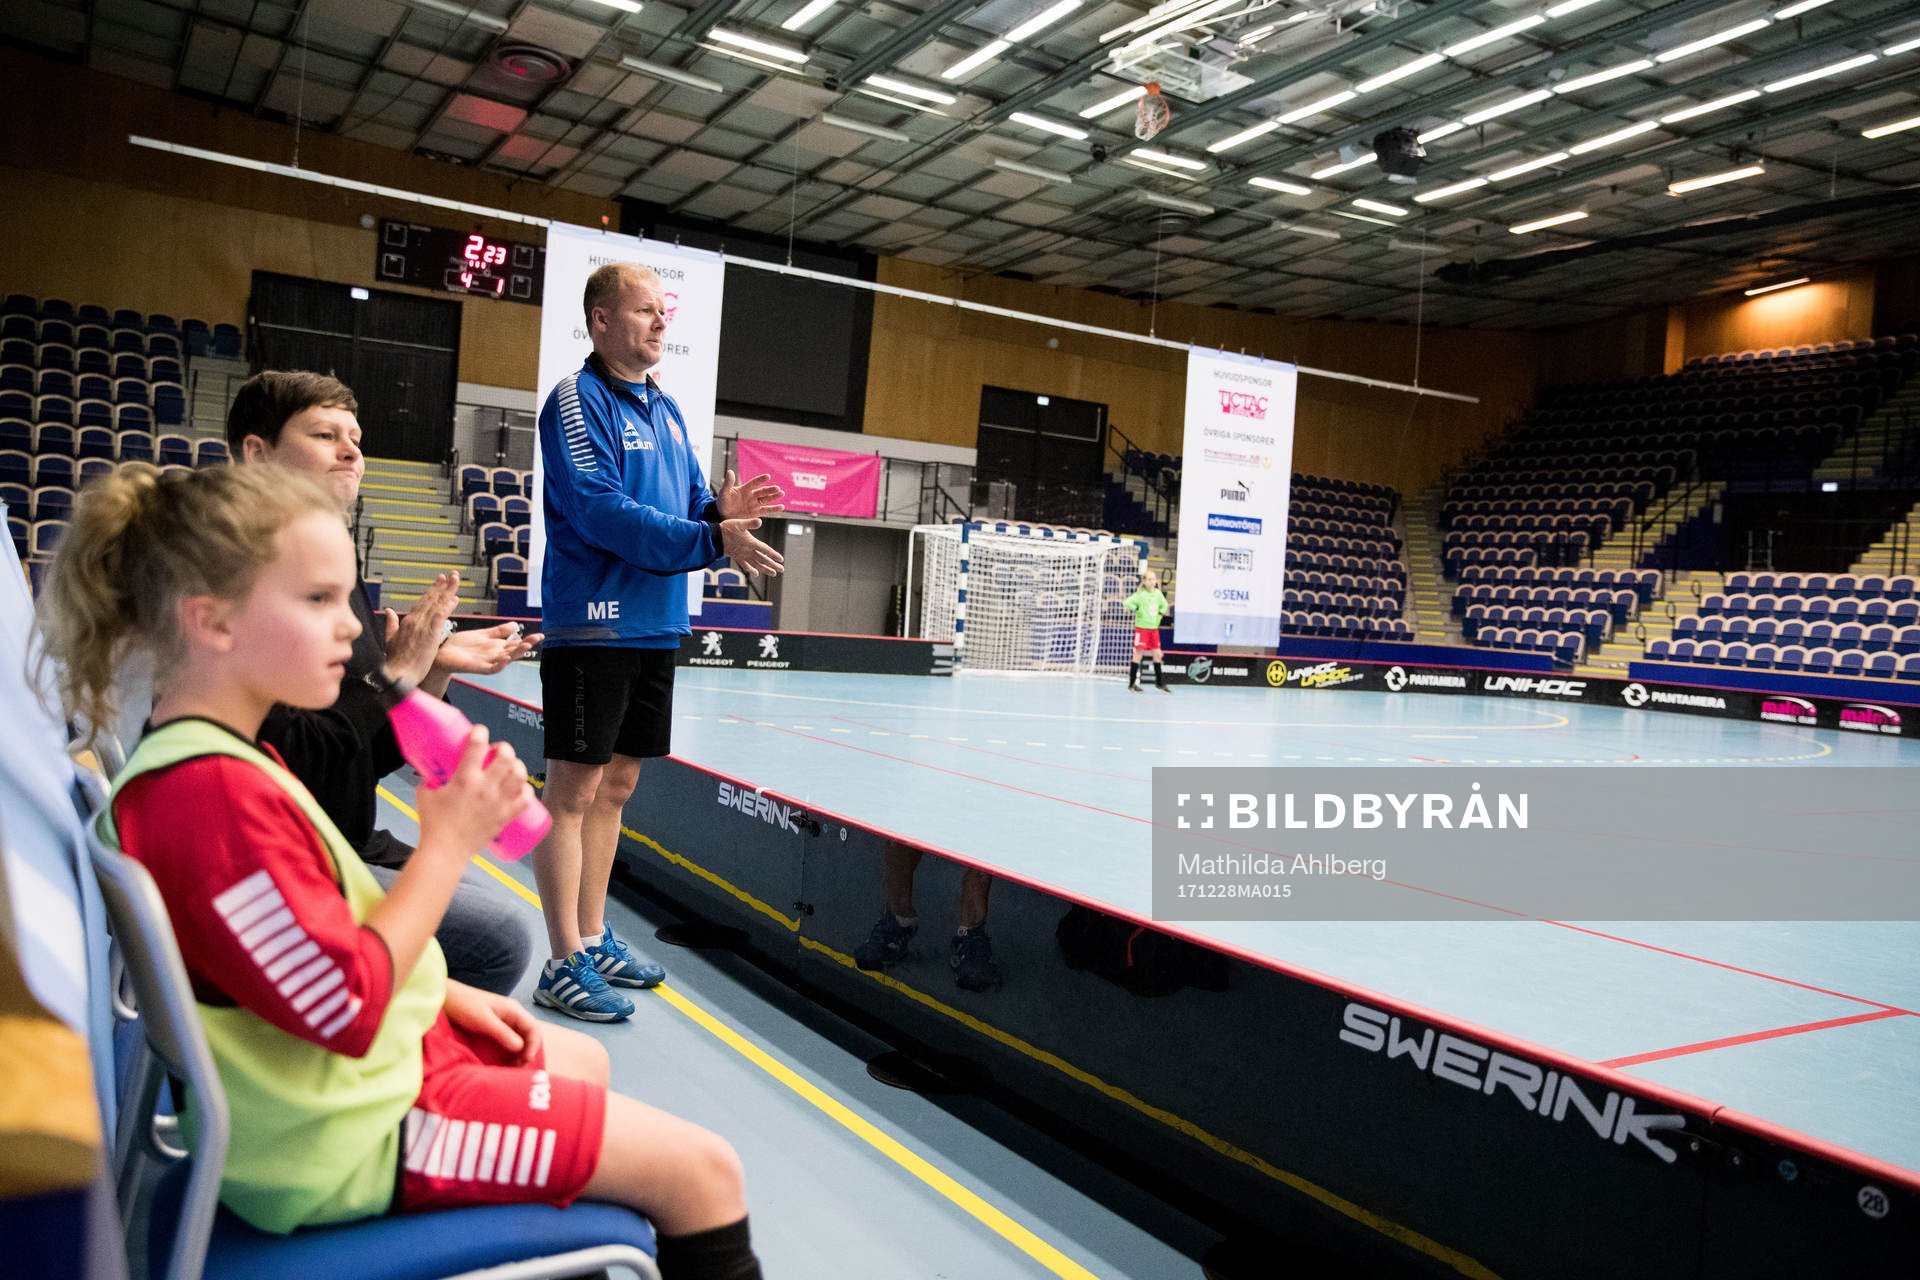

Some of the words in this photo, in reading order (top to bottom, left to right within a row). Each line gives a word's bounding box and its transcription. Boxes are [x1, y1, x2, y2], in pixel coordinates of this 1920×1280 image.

[464, 235, 484, 260] 2
[460, 272, 473, 289] 4
[1218, 390, 1269, 413] TICTAC
[1220, 488, 1247, 502] PUMA
[587, 601, 620, 620] ME
[689, 657, 735, 667] PEUGEOT
[746, 659, 791, 670] PEUGEOT
[1287, 661, 1338, 681] UNIHOC
[1300, 667, 1352, 687] UNIHOC
[1409, 673, 1467, 689] PANTAMERA
[1484, 675, 1588, 697] UNIHOC
[1650, 691, 1727, 709] PANTAMERA
[717, 781, 802, 835] SWERINK
[1338, 1002, 1687, 1164] SWERINK
[1862, 1190, 1885, 1213] 28
